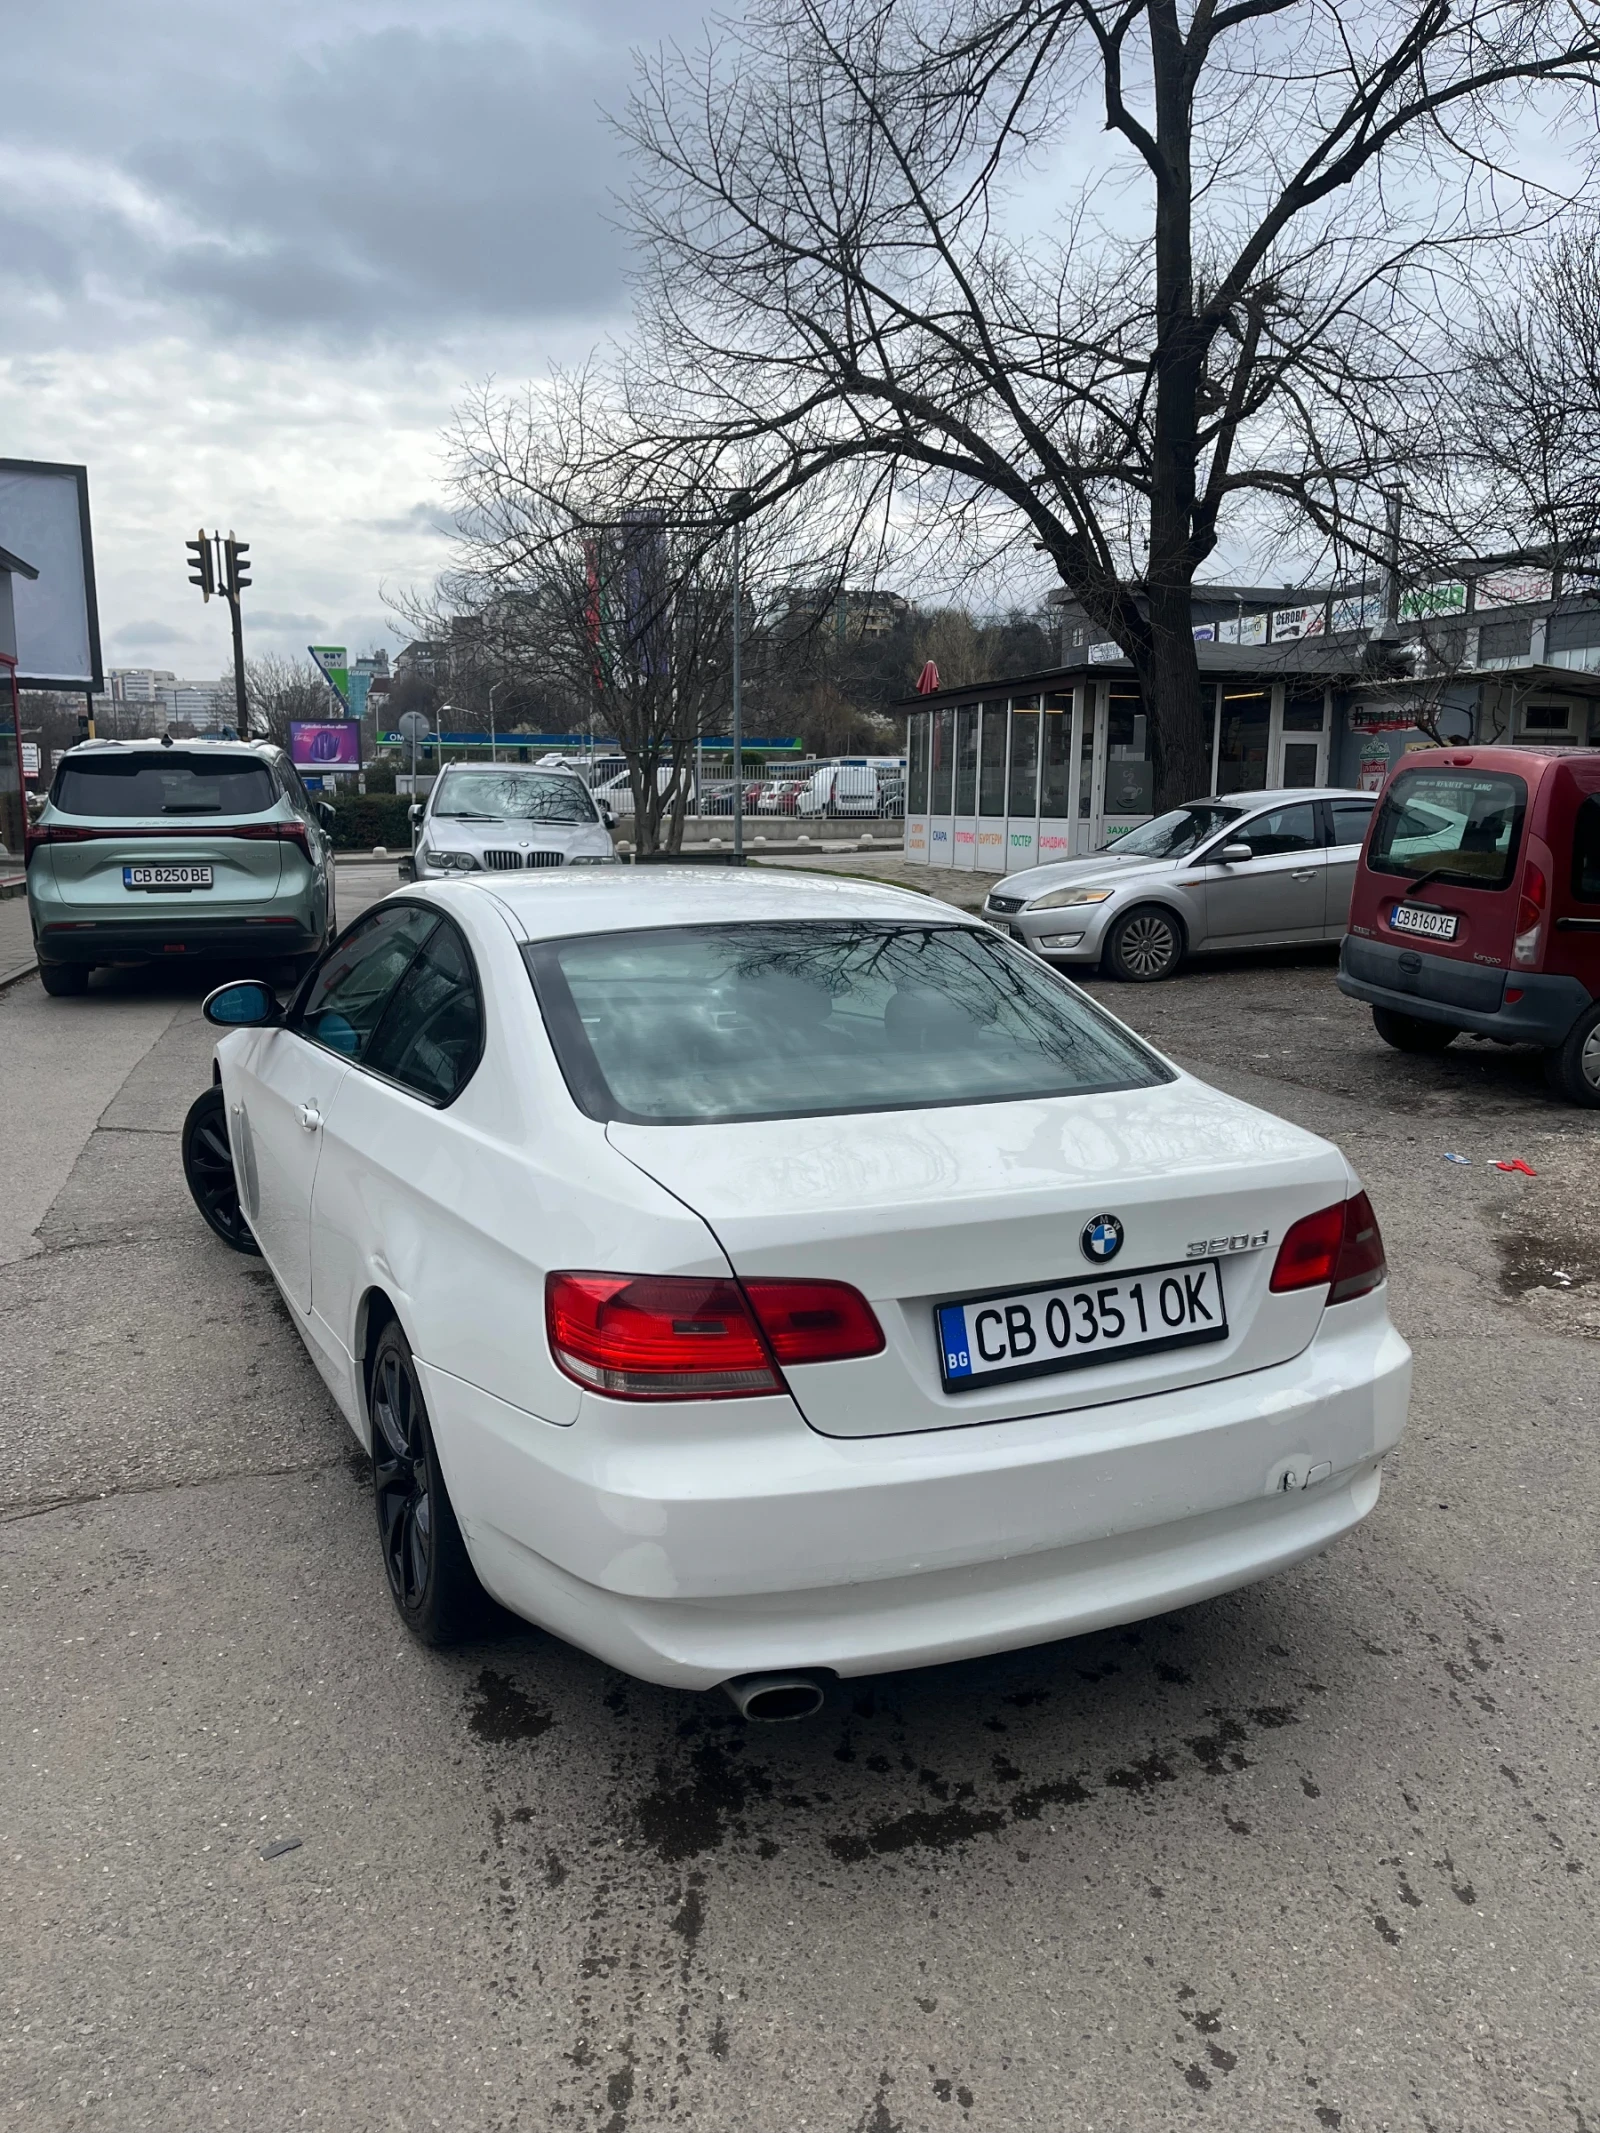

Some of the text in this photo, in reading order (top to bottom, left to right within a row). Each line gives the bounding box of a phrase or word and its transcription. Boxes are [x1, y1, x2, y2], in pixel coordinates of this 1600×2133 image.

[323, 660, 342, 668] OMV
[389, 733, 405, 742] OM
[932, 830, 948, 842] СКАРА
[979, 833, 1002, 845] БУРГЕРИ
[1010, 834, 1032, 847] ТОСТЕР
[133, 868, 210, 883] CB 8250 BE
[1397, 909, 1411, 925] CB
[1411, 912, 1437, 931] 8160
[1437, 917, 1454, 935] XE
[1473, 952, 1501, 965] Kangoo
[1086, 1213, 1123, 1235] BMW
[1186, 1229, 1270, 1258] 320d
[974, 1271, 1214, 1362] CB 0351 OK
[948, 1352, 969, 1369] BG
